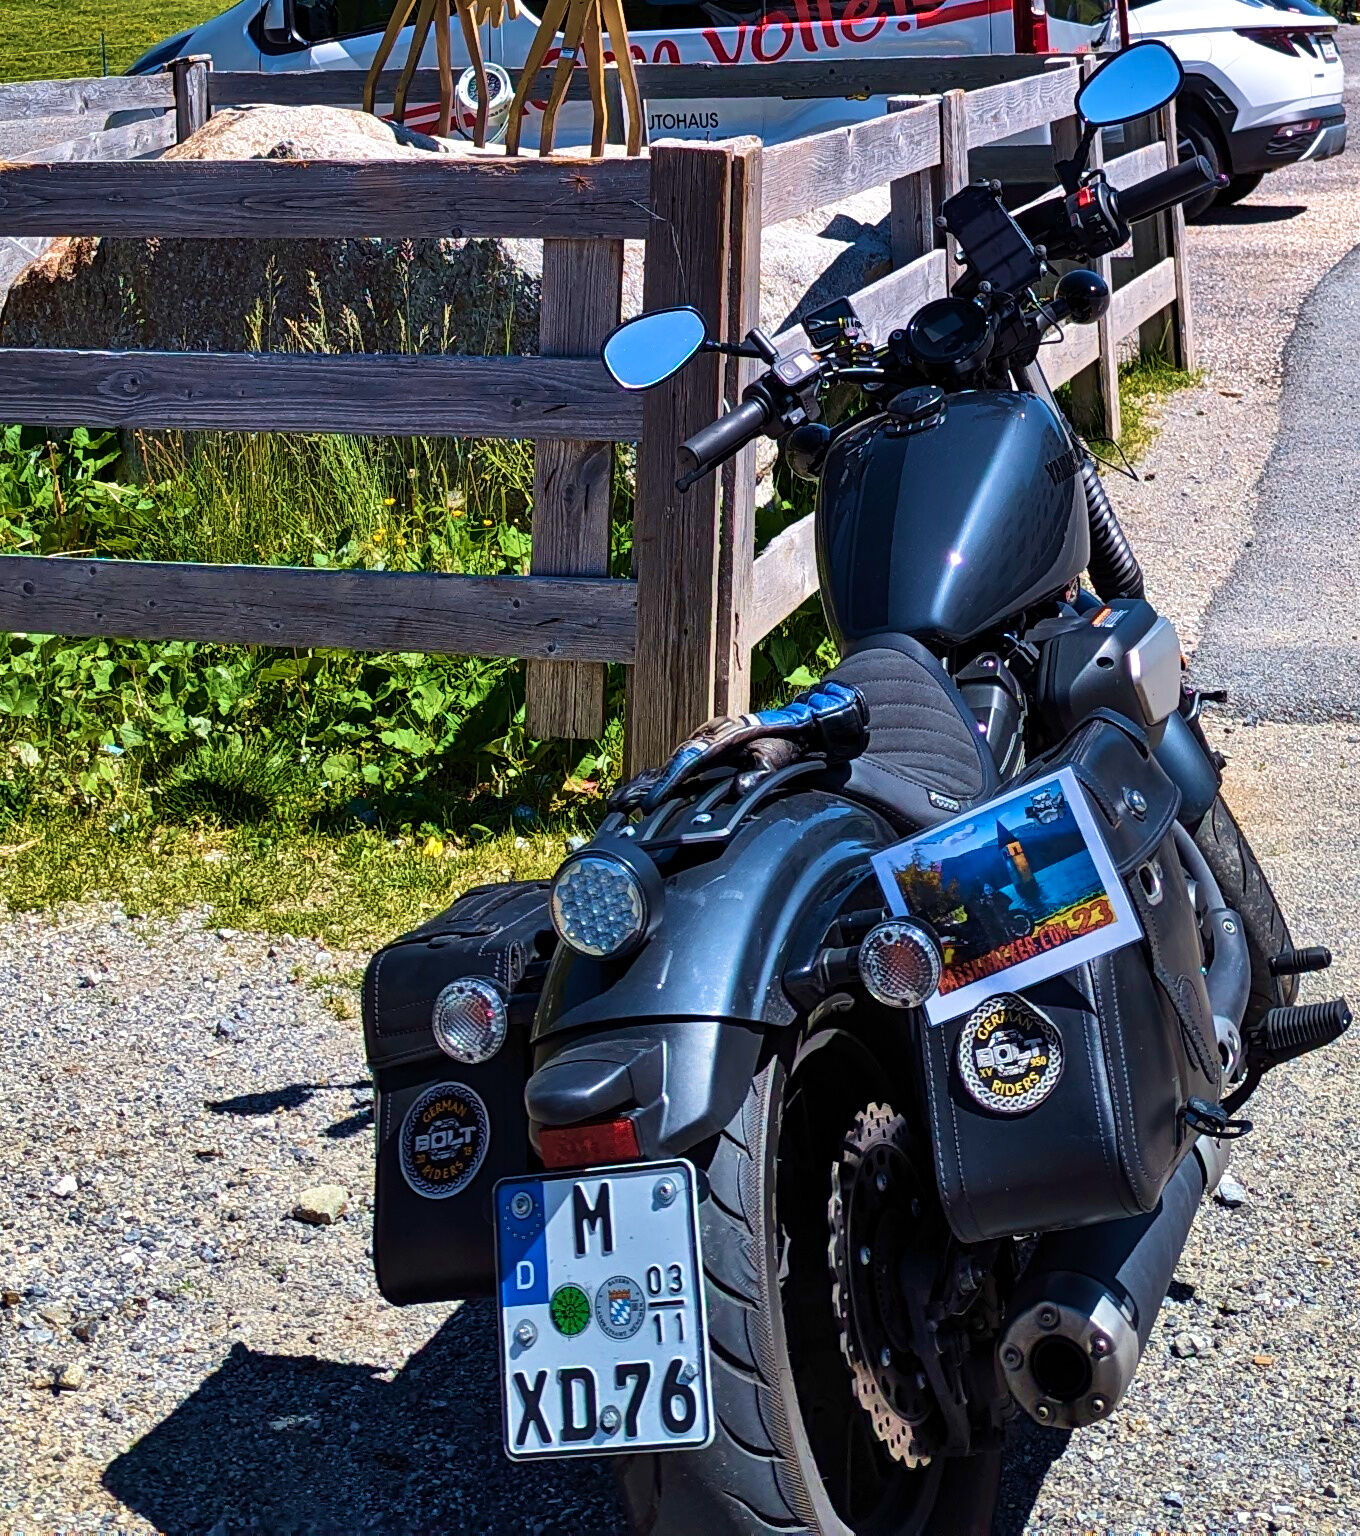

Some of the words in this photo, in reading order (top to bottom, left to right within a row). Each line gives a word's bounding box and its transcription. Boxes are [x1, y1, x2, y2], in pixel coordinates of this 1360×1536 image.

[648, 112, 719, 129] UTOHAUS
[977, 1010, 1033, 1040] GERMAN
[979, 1067, 993, 1079] XV
[1030, 1056, 1047, 1067] 950
[991, 1071, 1040, 1096] RIDERS
[422, 1099, 468, 1123] GERMAN
[415, 1126, 476, 1152] BOLT
[422, 1161, 464, 1180] RIDERS
[573, 1181, 614, 1257] M
[516, 1261, 535, 1290] D
[647, 1264, 683, 1295] 03
[652, 1311, 685, 1344] 11
